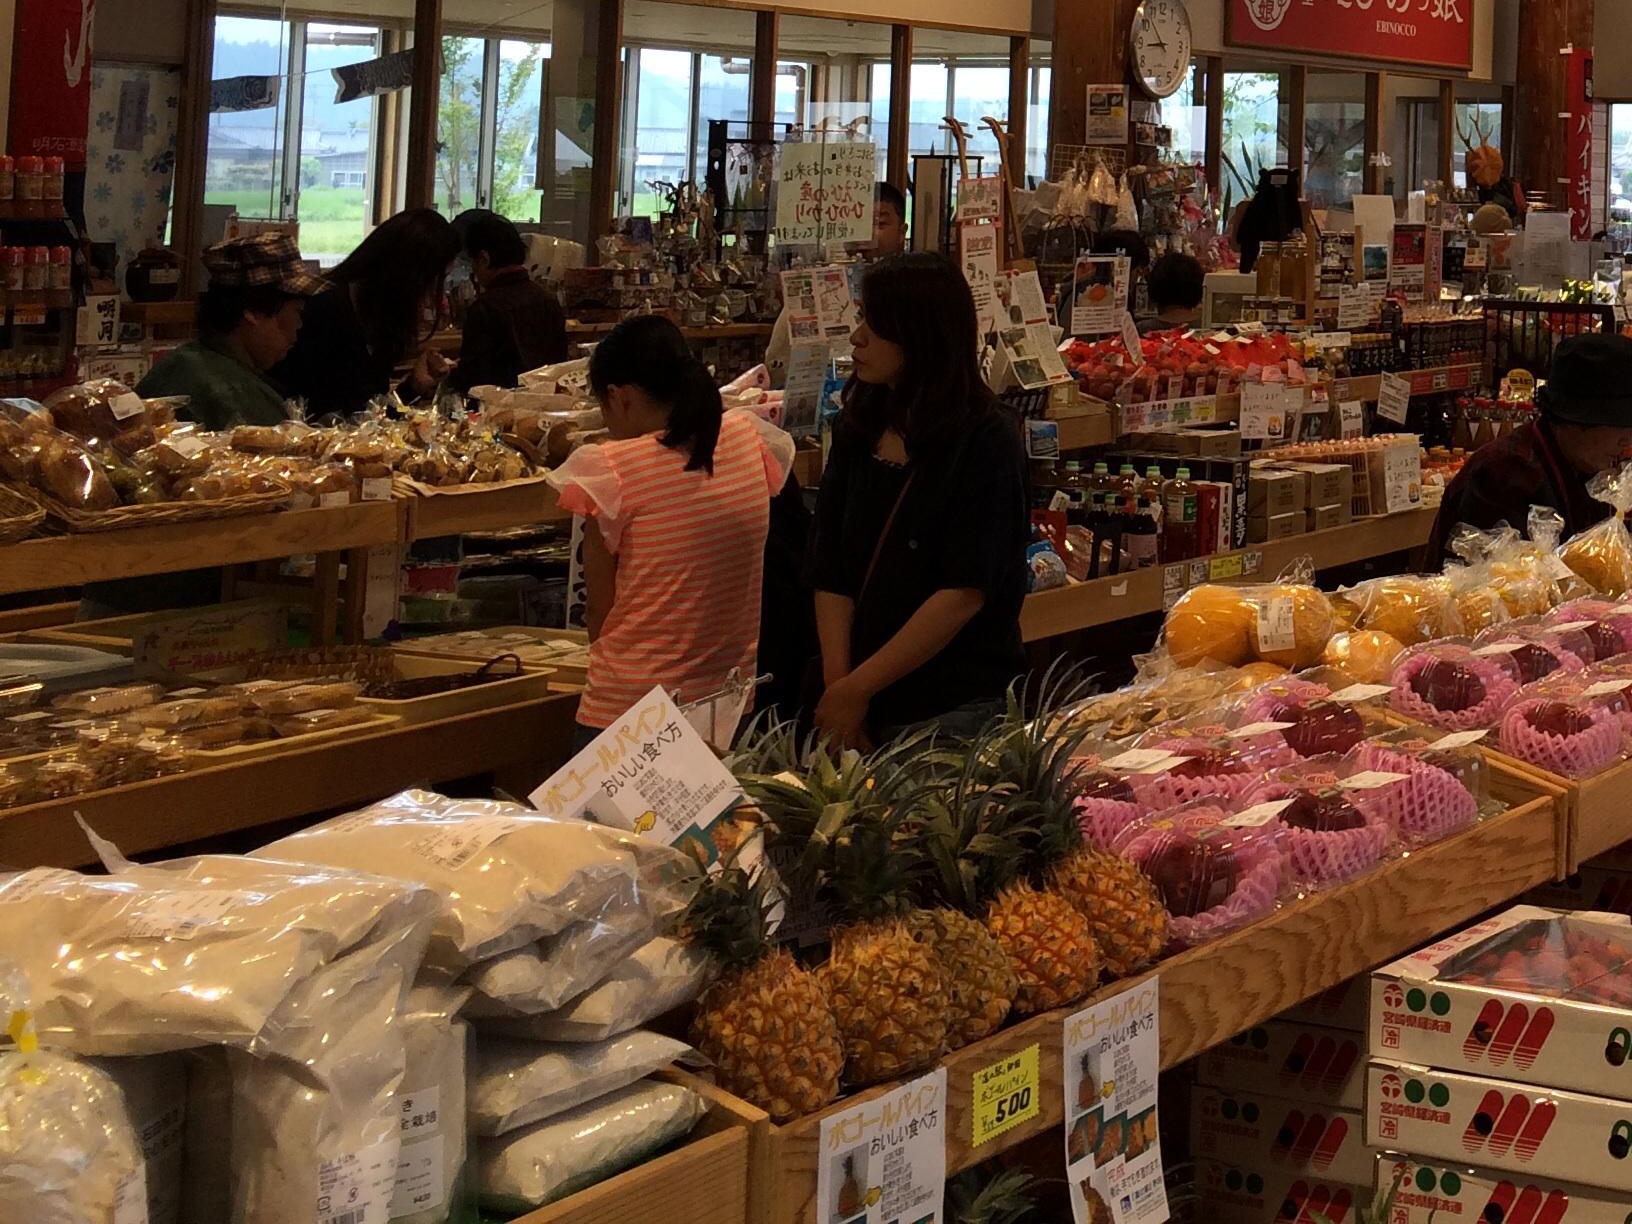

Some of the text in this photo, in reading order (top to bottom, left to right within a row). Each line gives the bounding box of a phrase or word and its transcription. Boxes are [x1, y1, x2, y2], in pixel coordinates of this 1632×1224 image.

[1376, 19, 1417, 37] EBINOCCO
[96, 298, 116, 342] 明月
[600, 721, 683, 798] おいしい食べ方
[1099, 1013, 1154, 1054] おいしい食べ方
[995, 1087, 1031, 1123] 500
[870, 1109, 938, 1156] おいしい食べ方
